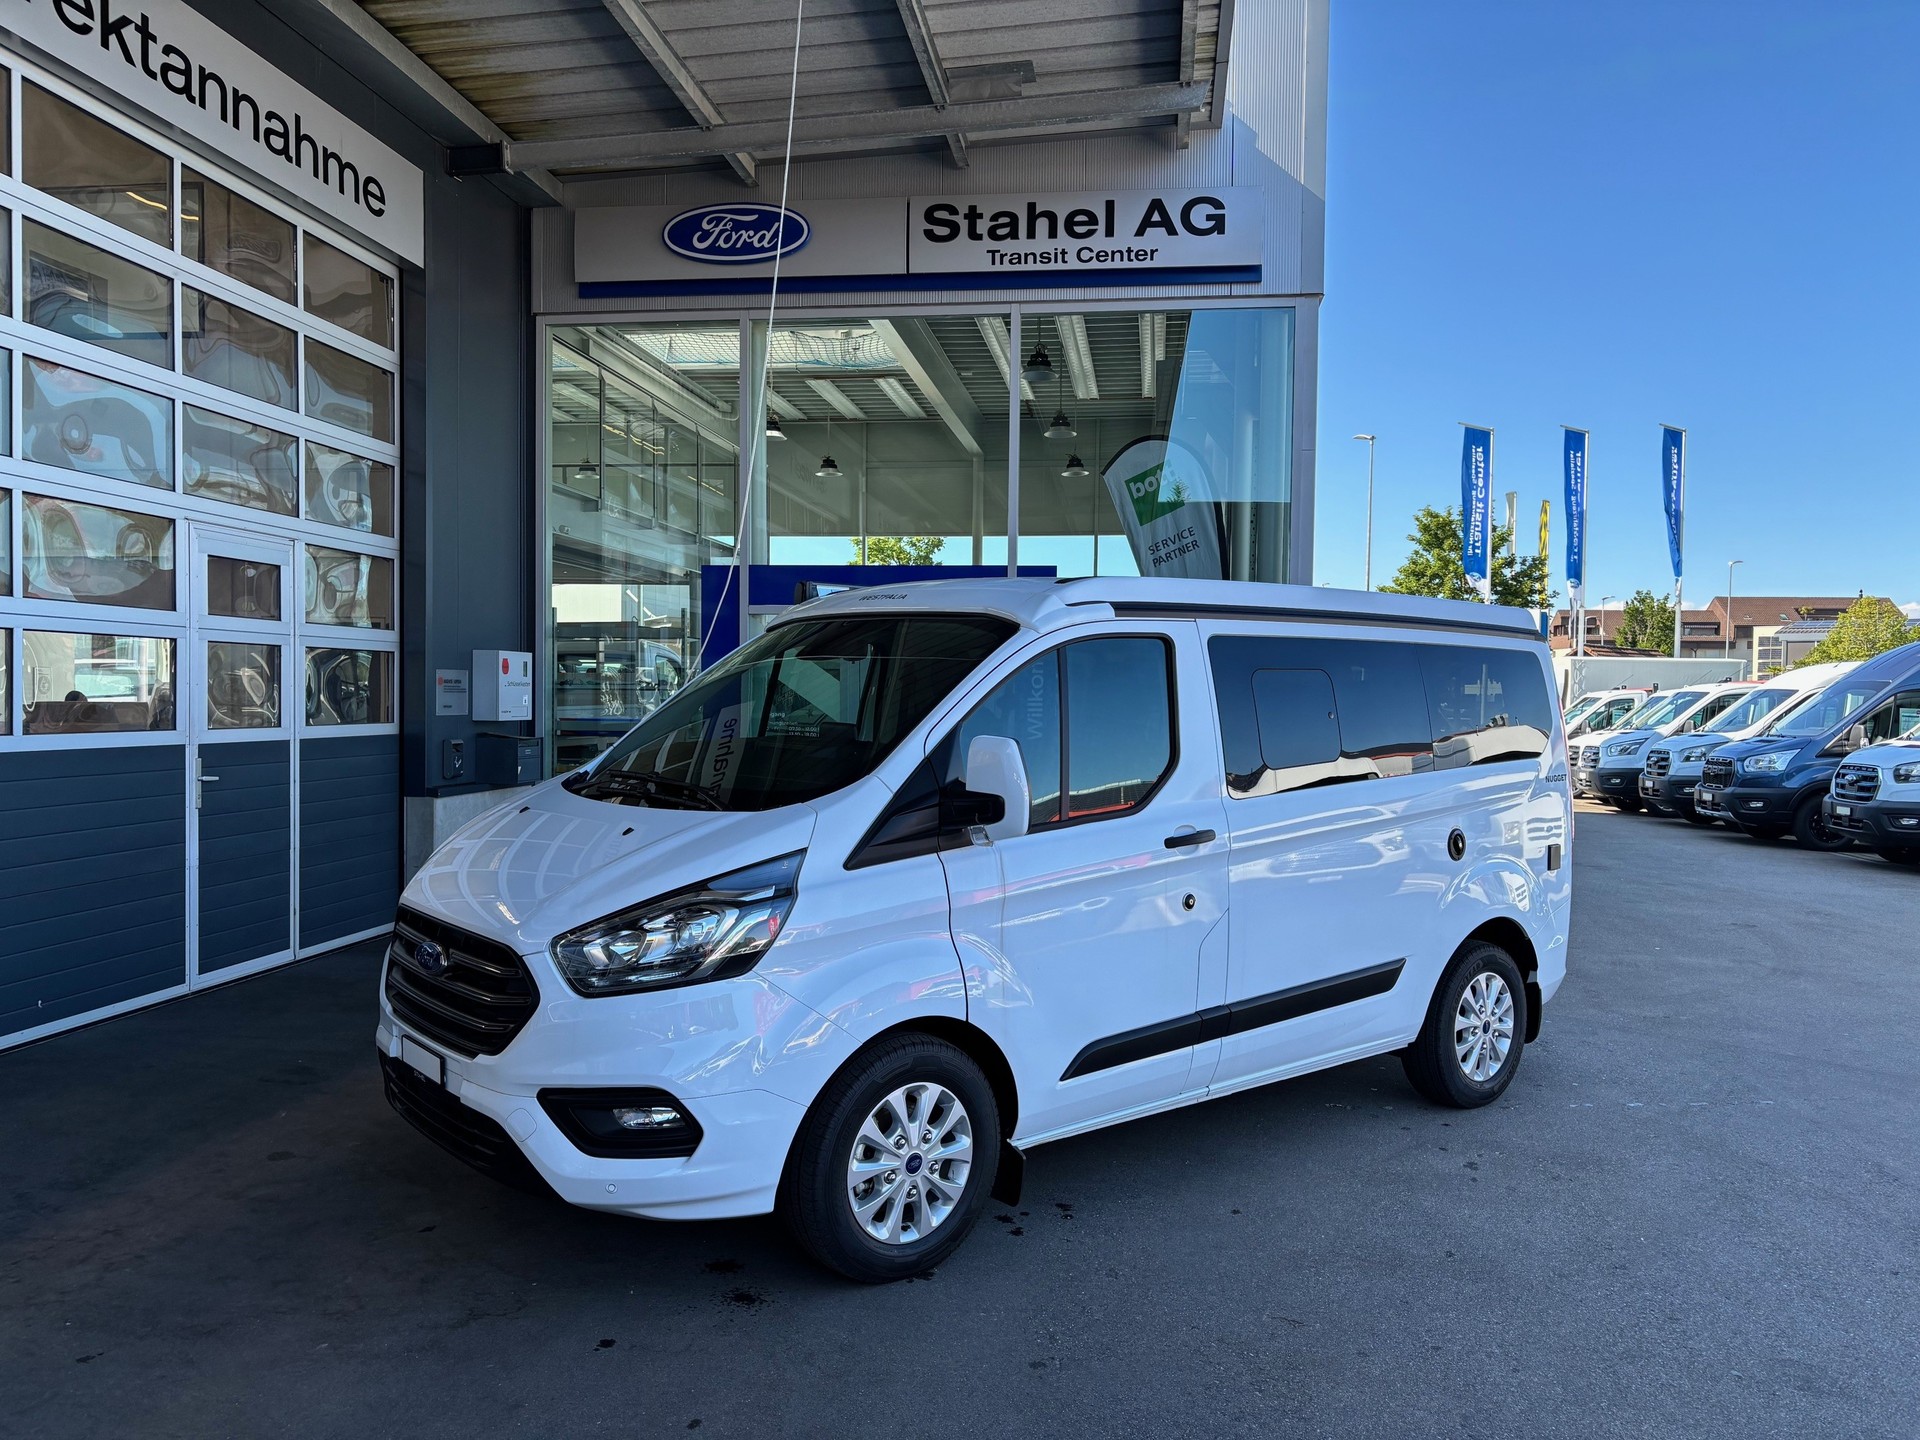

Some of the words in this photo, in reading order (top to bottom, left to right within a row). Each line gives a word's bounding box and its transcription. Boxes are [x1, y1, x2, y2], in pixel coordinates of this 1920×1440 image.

[25, 0, 386, 218] ektannahme
[692, 213, 780, 250] Ford
[923, 200, 1115, 243] Stahel
[1134, 196, 1226, 238] AG
[986, 247, 1068, 266] Transit
[1076, 246, 1158, 264] Center
[1148, 526, 1195, 555] SERVICE
[1152, 540, 1200, 568] PARTNER
[1545, 774, 1567, 783] NUGGET
